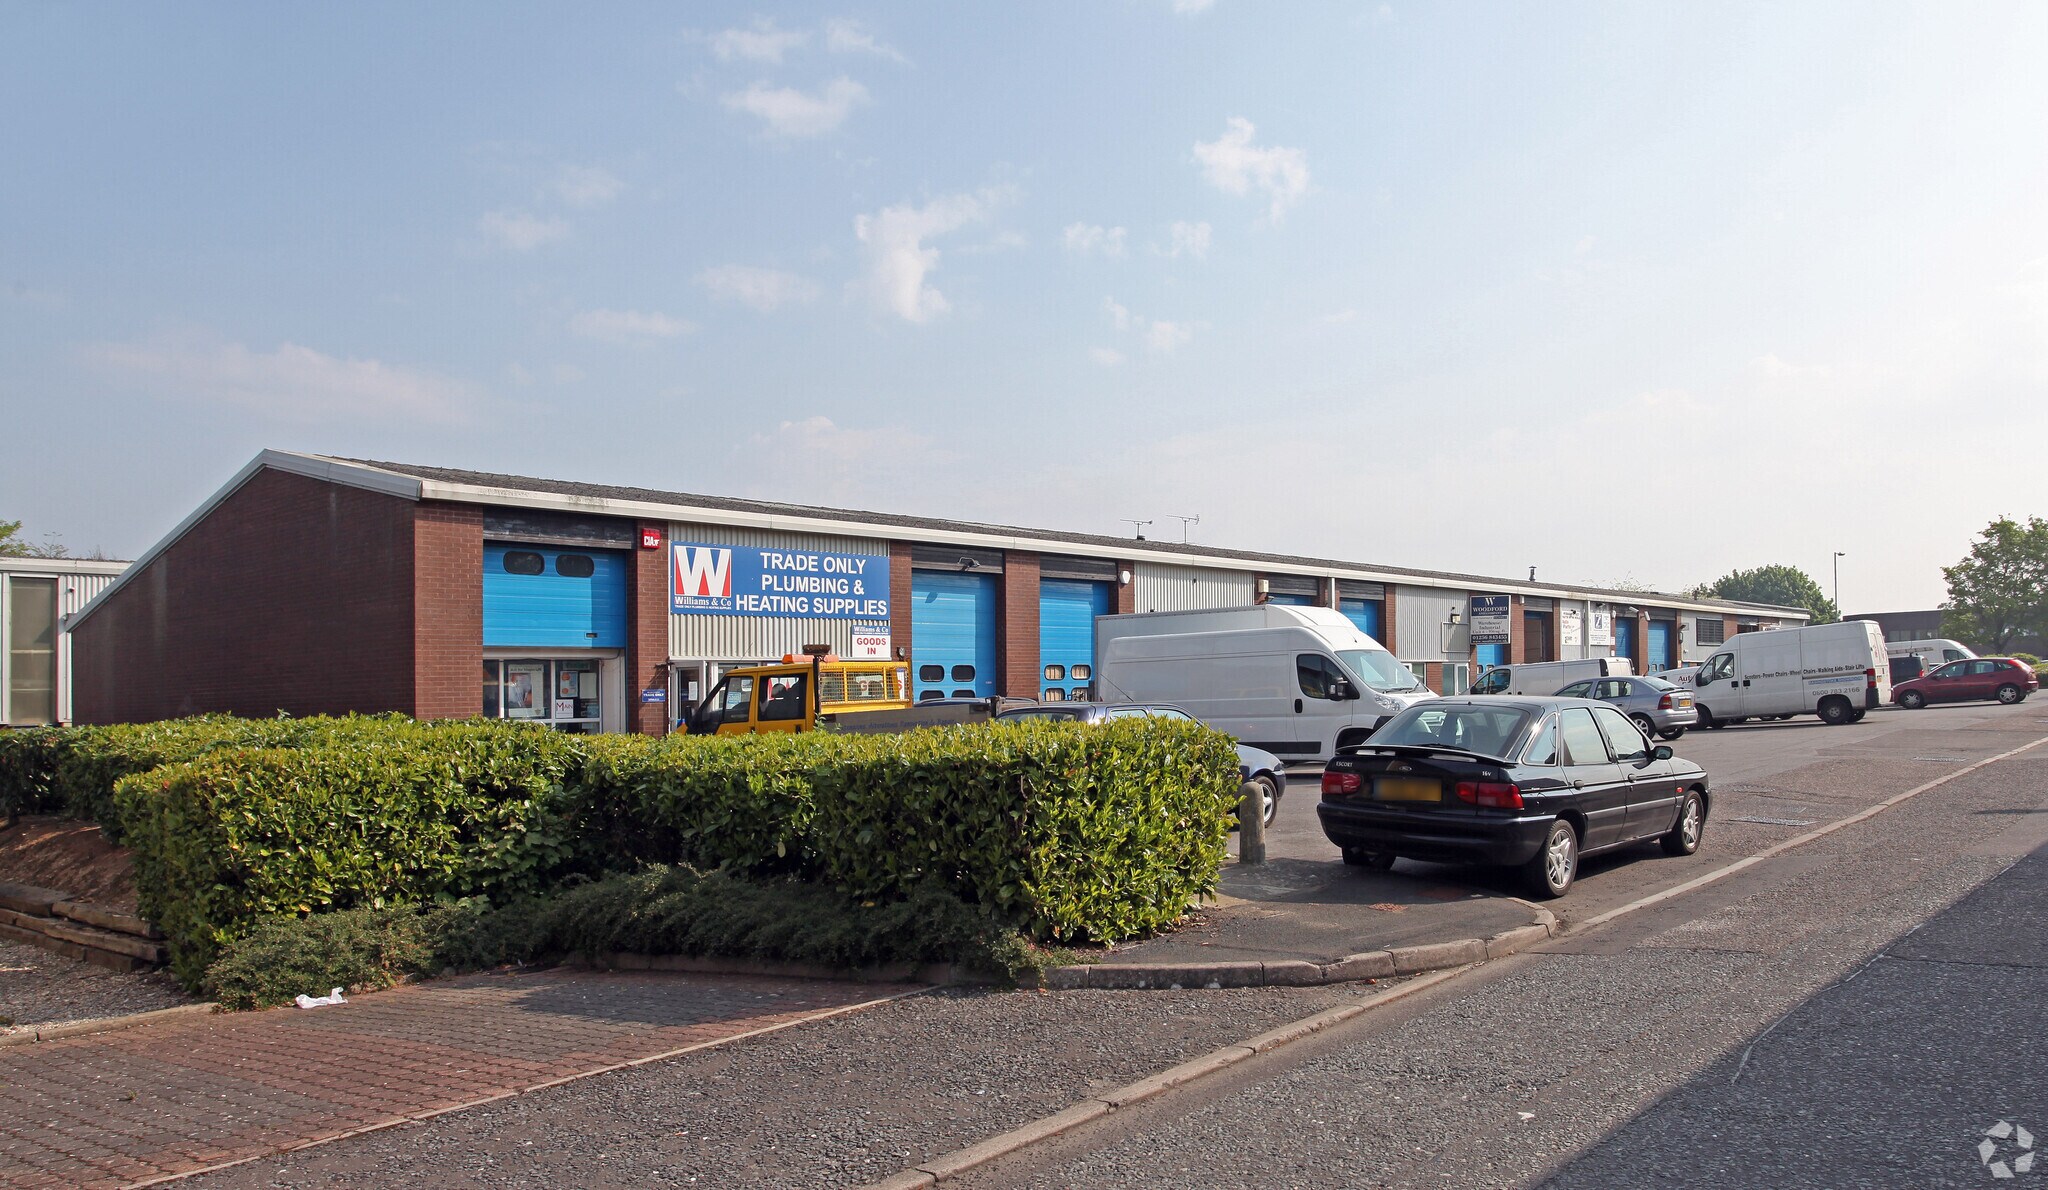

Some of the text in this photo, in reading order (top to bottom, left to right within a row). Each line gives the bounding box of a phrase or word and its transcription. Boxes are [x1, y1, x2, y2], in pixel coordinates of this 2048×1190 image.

[760, 552, 866, 574] TRADE ONLY
[761, 574, 865, 595] PLUMBING &
[674, 596, 732, 606] Williams & Co
[736, 594, 887, 616] HEATING SUPPLIES
[857, 637, 886, 645] GOODS
[867, 647, 876, 655] IN
